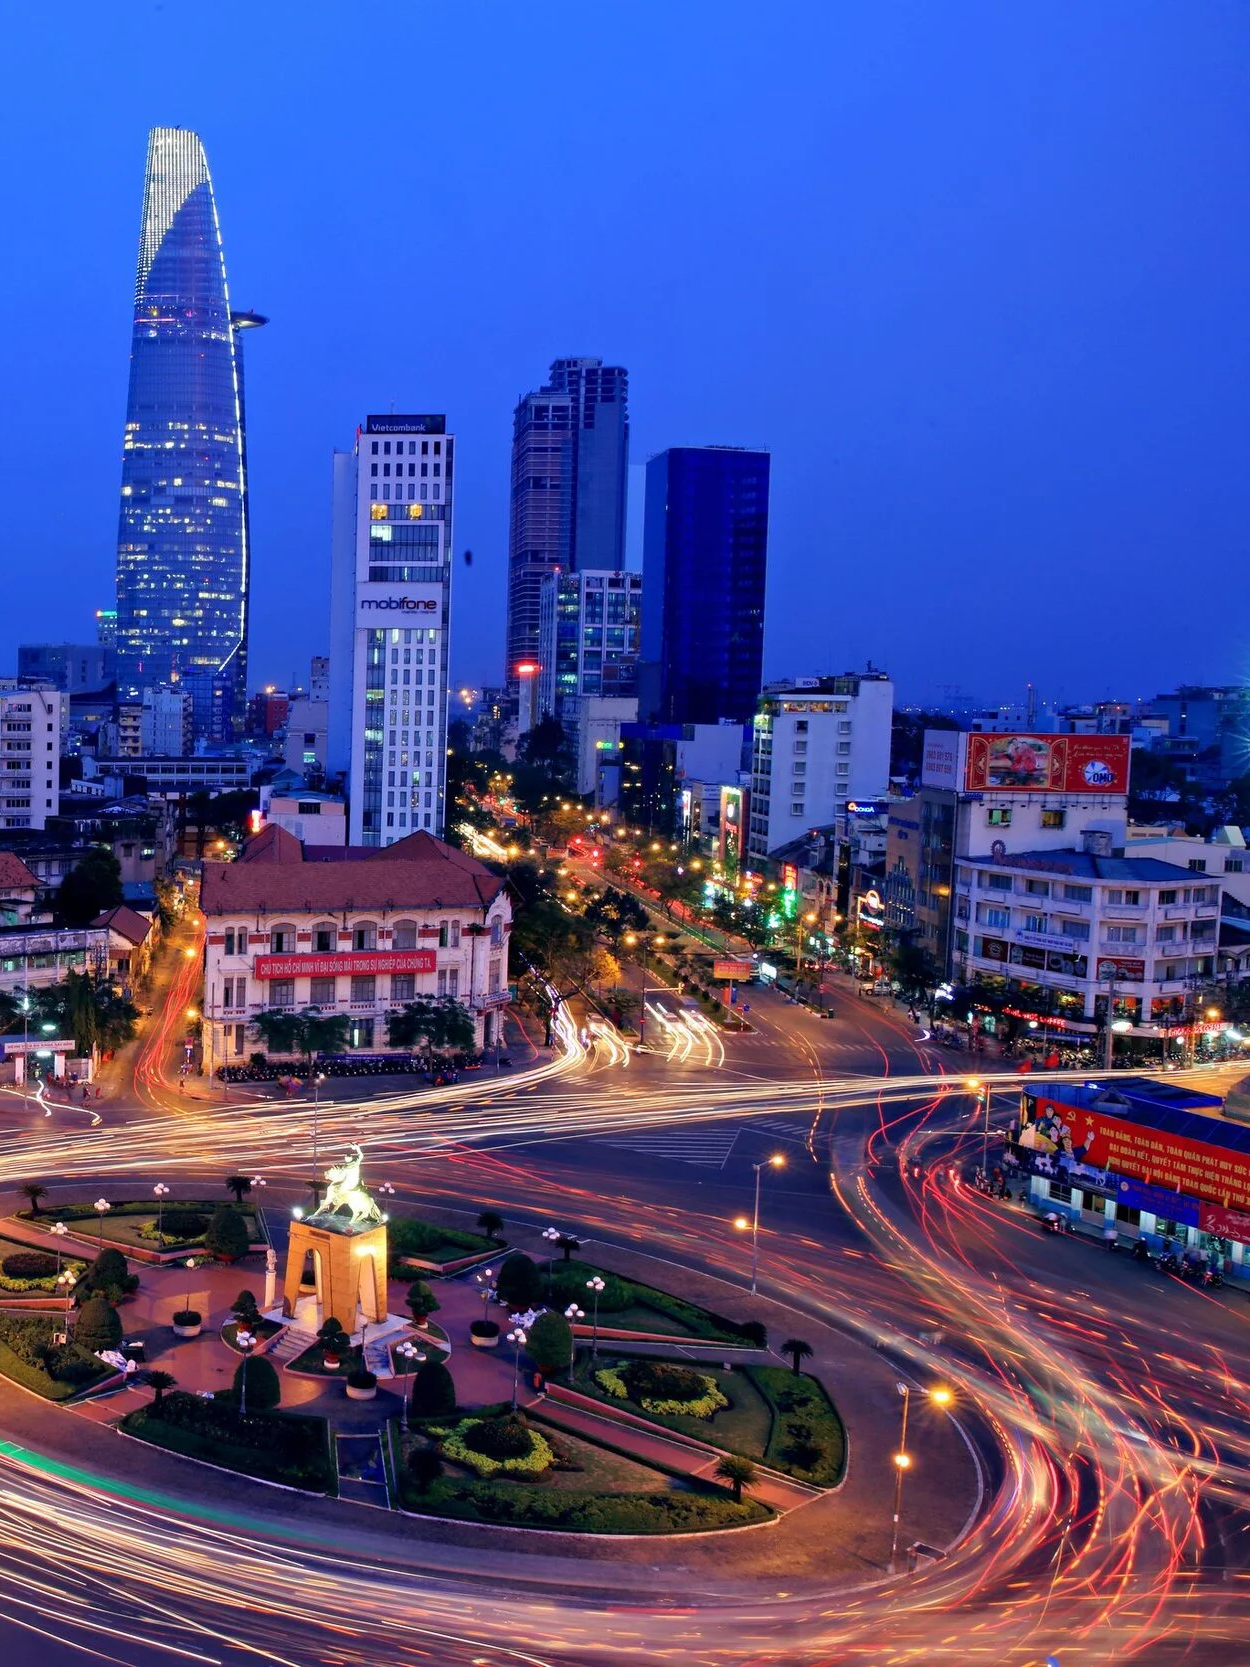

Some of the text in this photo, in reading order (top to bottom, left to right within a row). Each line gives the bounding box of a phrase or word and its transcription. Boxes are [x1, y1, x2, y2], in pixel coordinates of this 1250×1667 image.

[372, 423, 426, 432] Vietcombank
[361, 597, 437, 611] mobifone
[1093, 773, 1114, 784] OMO
[260, 959, 271, 975] CHỦ
[272, 963, 283, 976] TỊCH
[284, 958, 292, 974] HỒ
[292, 959, 301, 973] CHÍ
[302, 962, 314, 973] MINH
[320, 961, 328, 975] ĐẠI
[329, 957, 343, 972] SỐNG
[354, 960, 369, 971] TRONG
[378, 956, 395, 972] NGHIỆP
[396, 955, 406, 969] CỦA
[407, 955, 423, 969] CHÚNG
[1099, 1126, 1115, 1138] TOÀN
[1134, 1136, 1150, 1148] TOÀN
[1166, 1145, 1183, 1157] TOÀN
[1183, 1150, 1201, 1162] QUÂN
[1201, 1155, 1218, 1167] PHÁT
[1219, 1160, 1233, 1171] HUY
[1233, 1163, 1248, 1176] SỨC
[1109, 1143, 1120, 1154] ĐẠI
[1151, 1155, 1171, 1168] QUYẾT
[1172, 1160, 1187, 1172] TÂM
[1188, 1165, 1204, 1177] THỰC
[1221, 1175, 1243, 1189] THẮNG
[1121, 1159, 1141, 1172] QUYẾT
[1182, 1177, 1199, 1189] TOÀN
[1200, 1182, 1217, 1196] QUỐC
